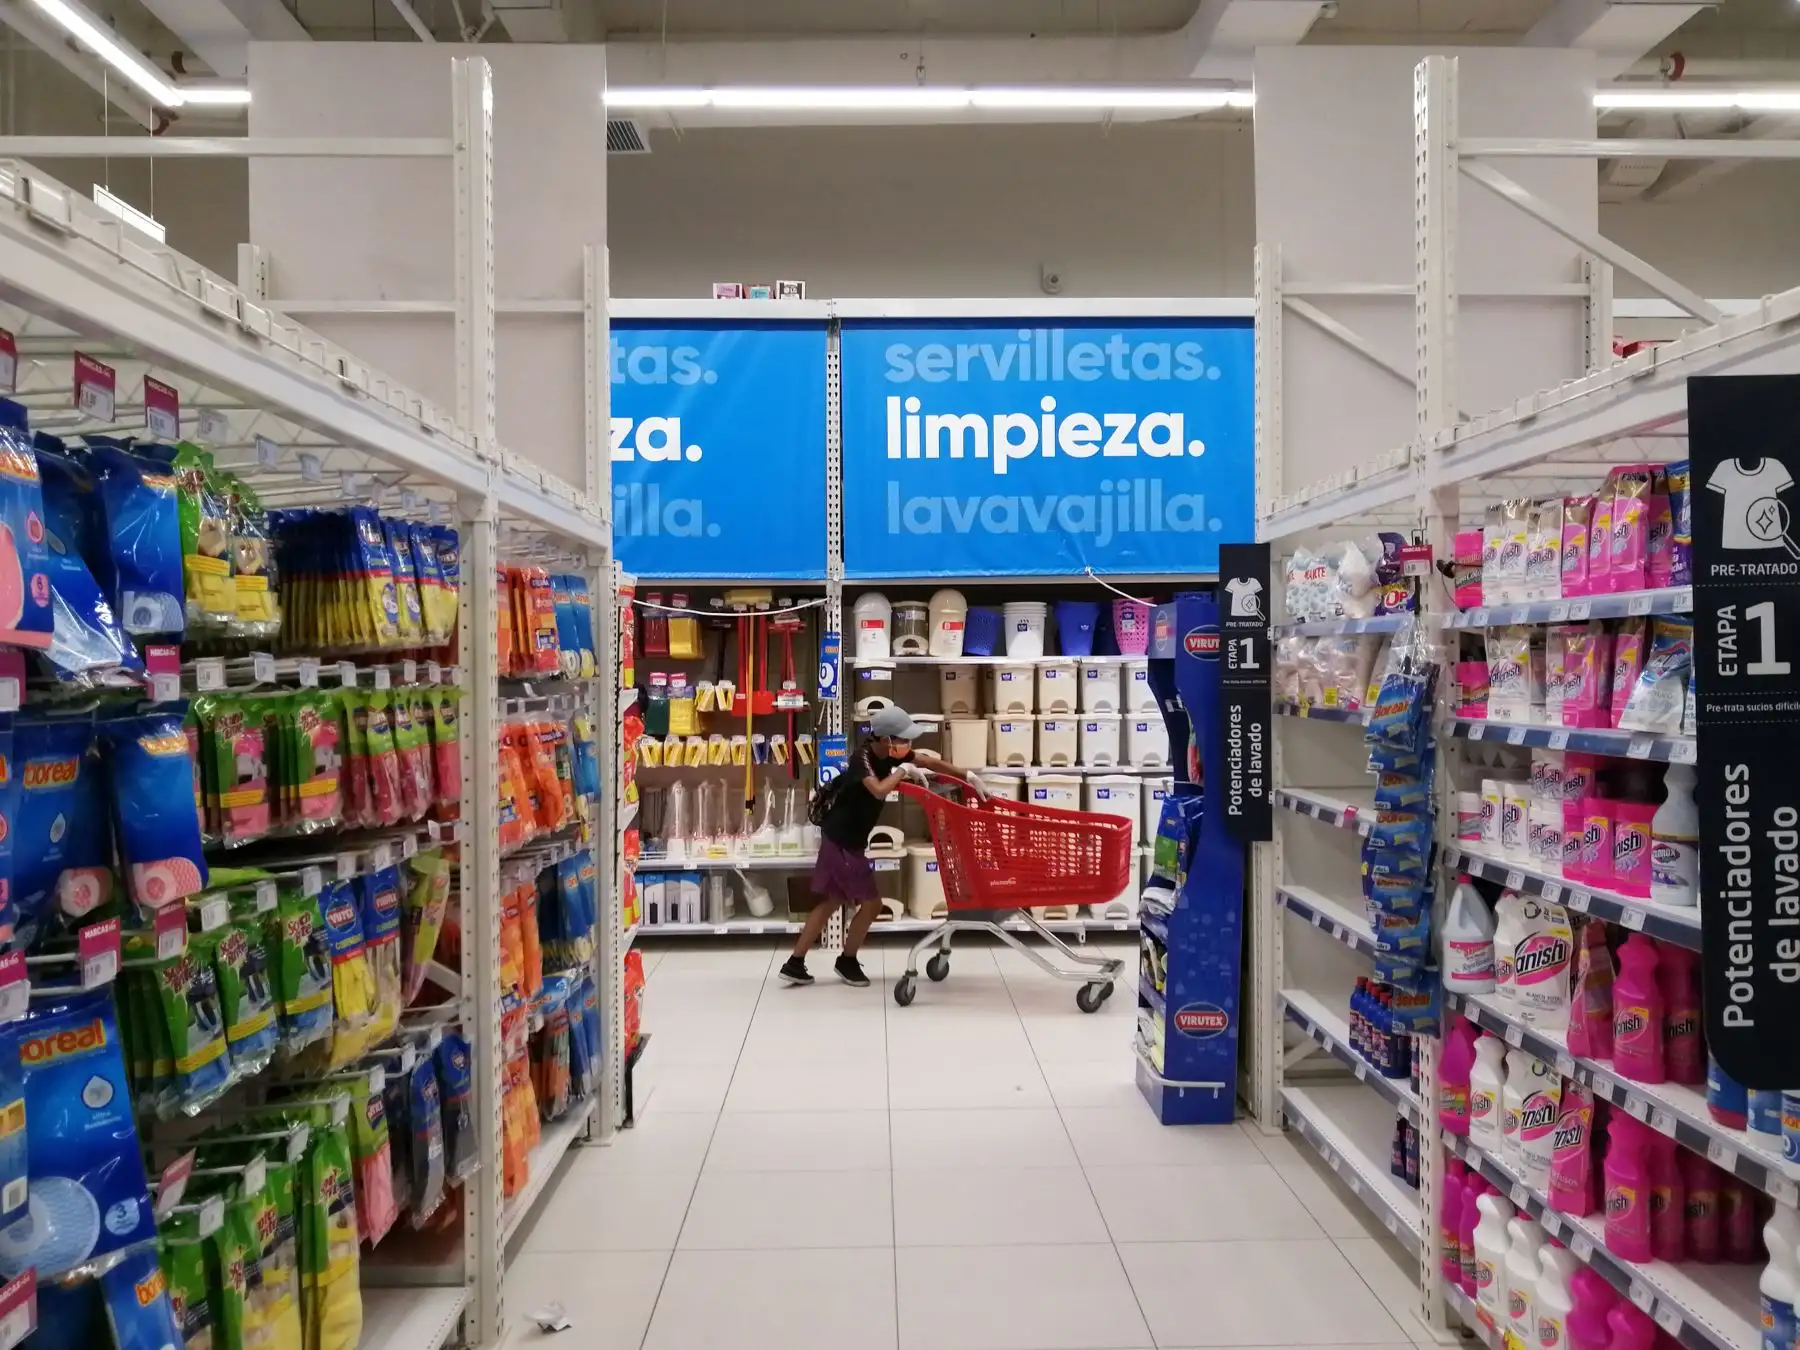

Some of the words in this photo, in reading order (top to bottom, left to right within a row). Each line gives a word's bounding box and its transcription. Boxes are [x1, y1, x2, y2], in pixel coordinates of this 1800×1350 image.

[884, 328, 1220, 383] servilletas.
[886, 396, 1205, 475] limpieza.
[614, 482, 721, 538] illa.
[887, 479, 1222, 547] lavavajilla.
[1711, 563, 1798, 577] PRE-TRATADO
[1228, 638, 1238, 669] ETAPA
[1240, 637, 1260, 669] 1
[1717, 604, 1738, 676] ETAPA
[1745, 601, 1791, 676] 1
[1706, 703, 1745, 713] Pre-trata
[1746, 702, 1774, 712] sucios
[1228, 704, 1242, 816] Potenciadores
[1247, 722, 1263, 774] lavado
[1247, 777, 1263, 798] de
[1766, 806, 1800, 926] lavado
[1718, 763, 1755, 1028] Potenciadores
[1769, 938, 1800, 983] de
[20, 1018, 104, 1062] oreal
[1179, 1014, 1223, 1027] VIRUTEX
